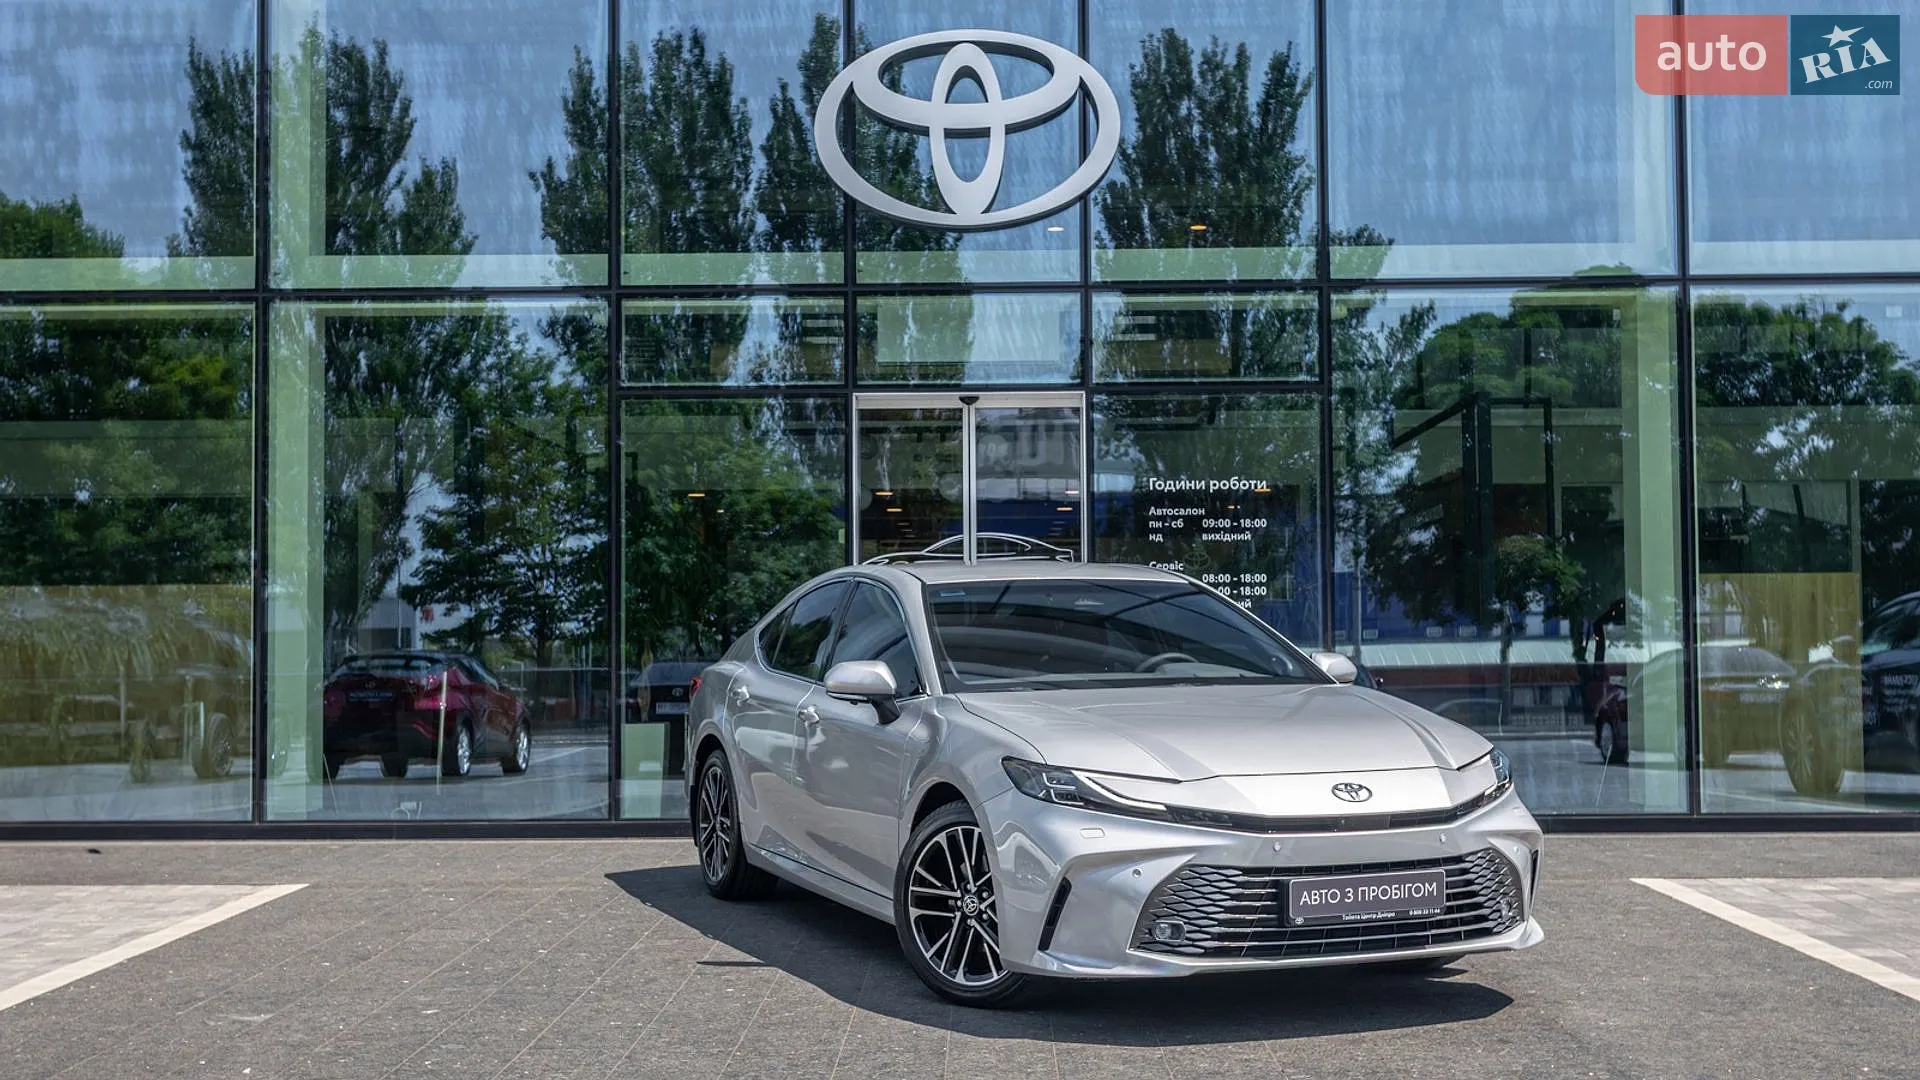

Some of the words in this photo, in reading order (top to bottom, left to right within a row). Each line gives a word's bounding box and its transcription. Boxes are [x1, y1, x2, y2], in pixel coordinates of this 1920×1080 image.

[1149, 477, 1205, 492] Години
[1209, 476, 1267, 493] роботи
[1148, 507, 1205, 516] Автосалон
[1171, 518, 1184, 528] сб
[1202, 518, 1231, 528] 09:00
[1240, 518, 1267, 528] 18:00
[1149, 534, 1163, 542] нд
[1202, 531, 1252, 542] вихідний
[1202, 573, 1231, 583] 08:00
[1240, 573, 1267, 583] 18:00
[1240, 586, 1267, 596] 18:00
[1299, 888, 1341, 906] АВТО
[1358, 881, 1437, 902] ПРОБІГОМ
